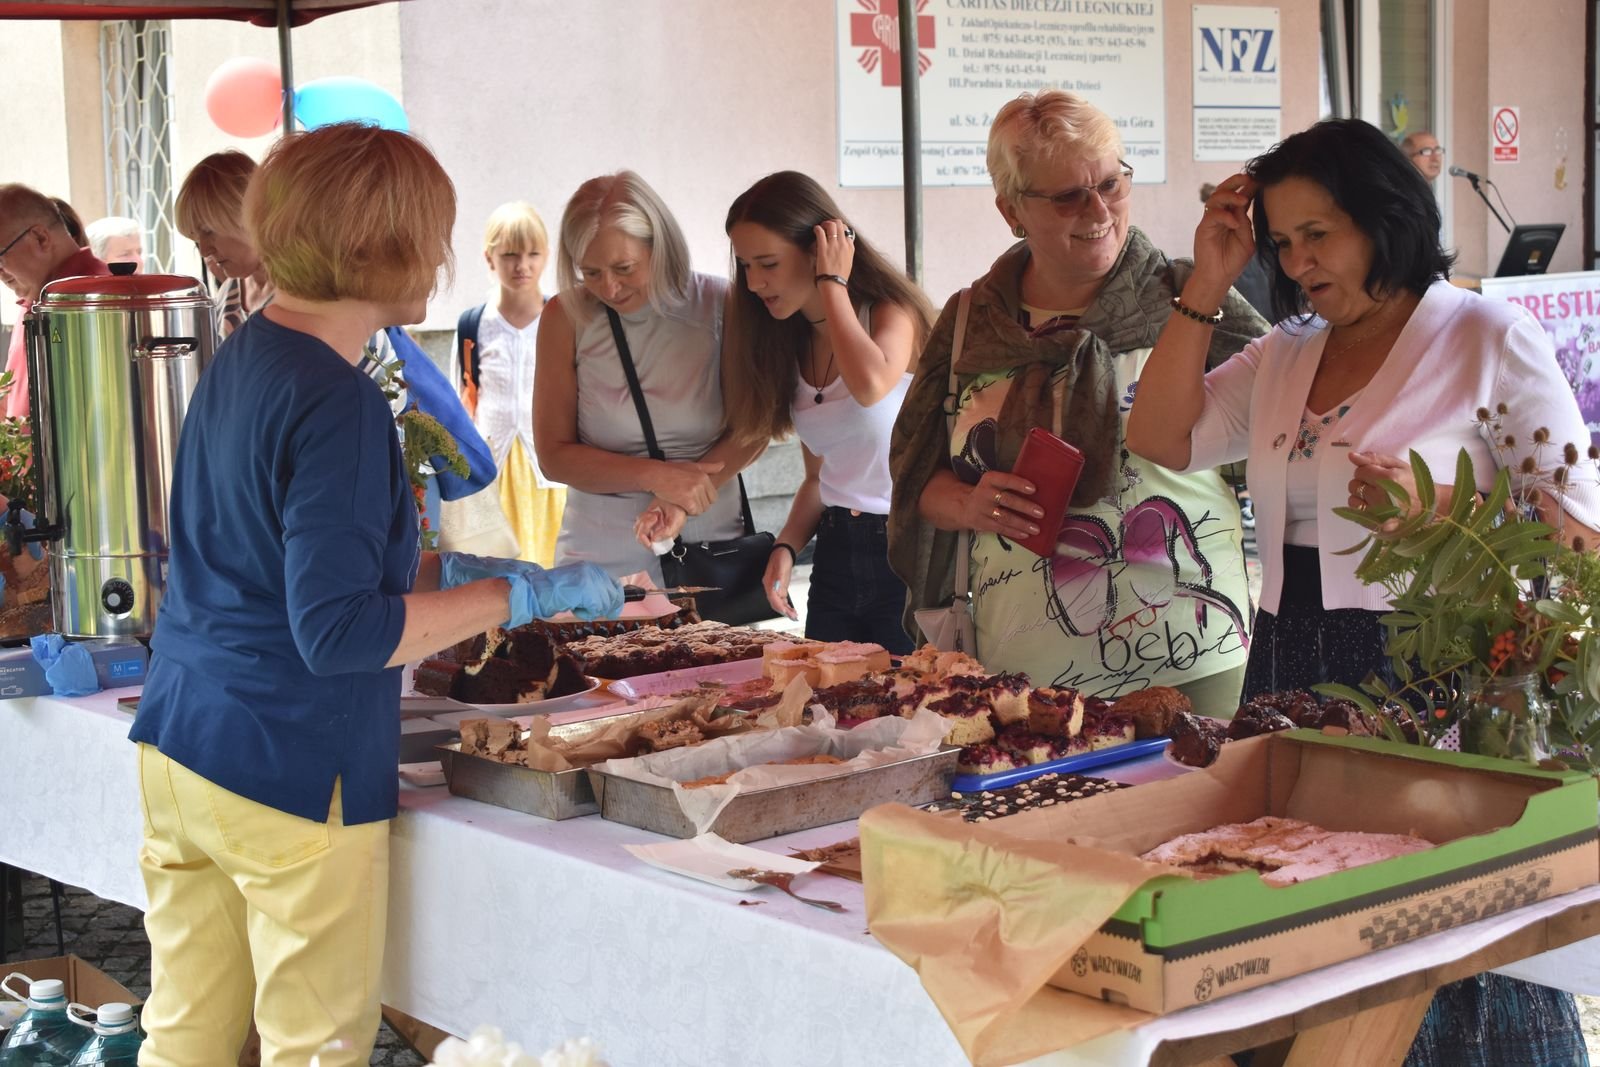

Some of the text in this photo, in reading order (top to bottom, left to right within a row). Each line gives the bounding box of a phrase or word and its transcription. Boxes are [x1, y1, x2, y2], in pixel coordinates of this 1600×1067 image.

[946, 0, 1154, 16] CARITAS DIECEZJI LEGNICKIEJ
[1198, 27, 1277, 73] NFZ
[1090, 955, 1142, 985] WARZYWNIAK
[1215, 957, 1271, 988] WARZYWNIAK
